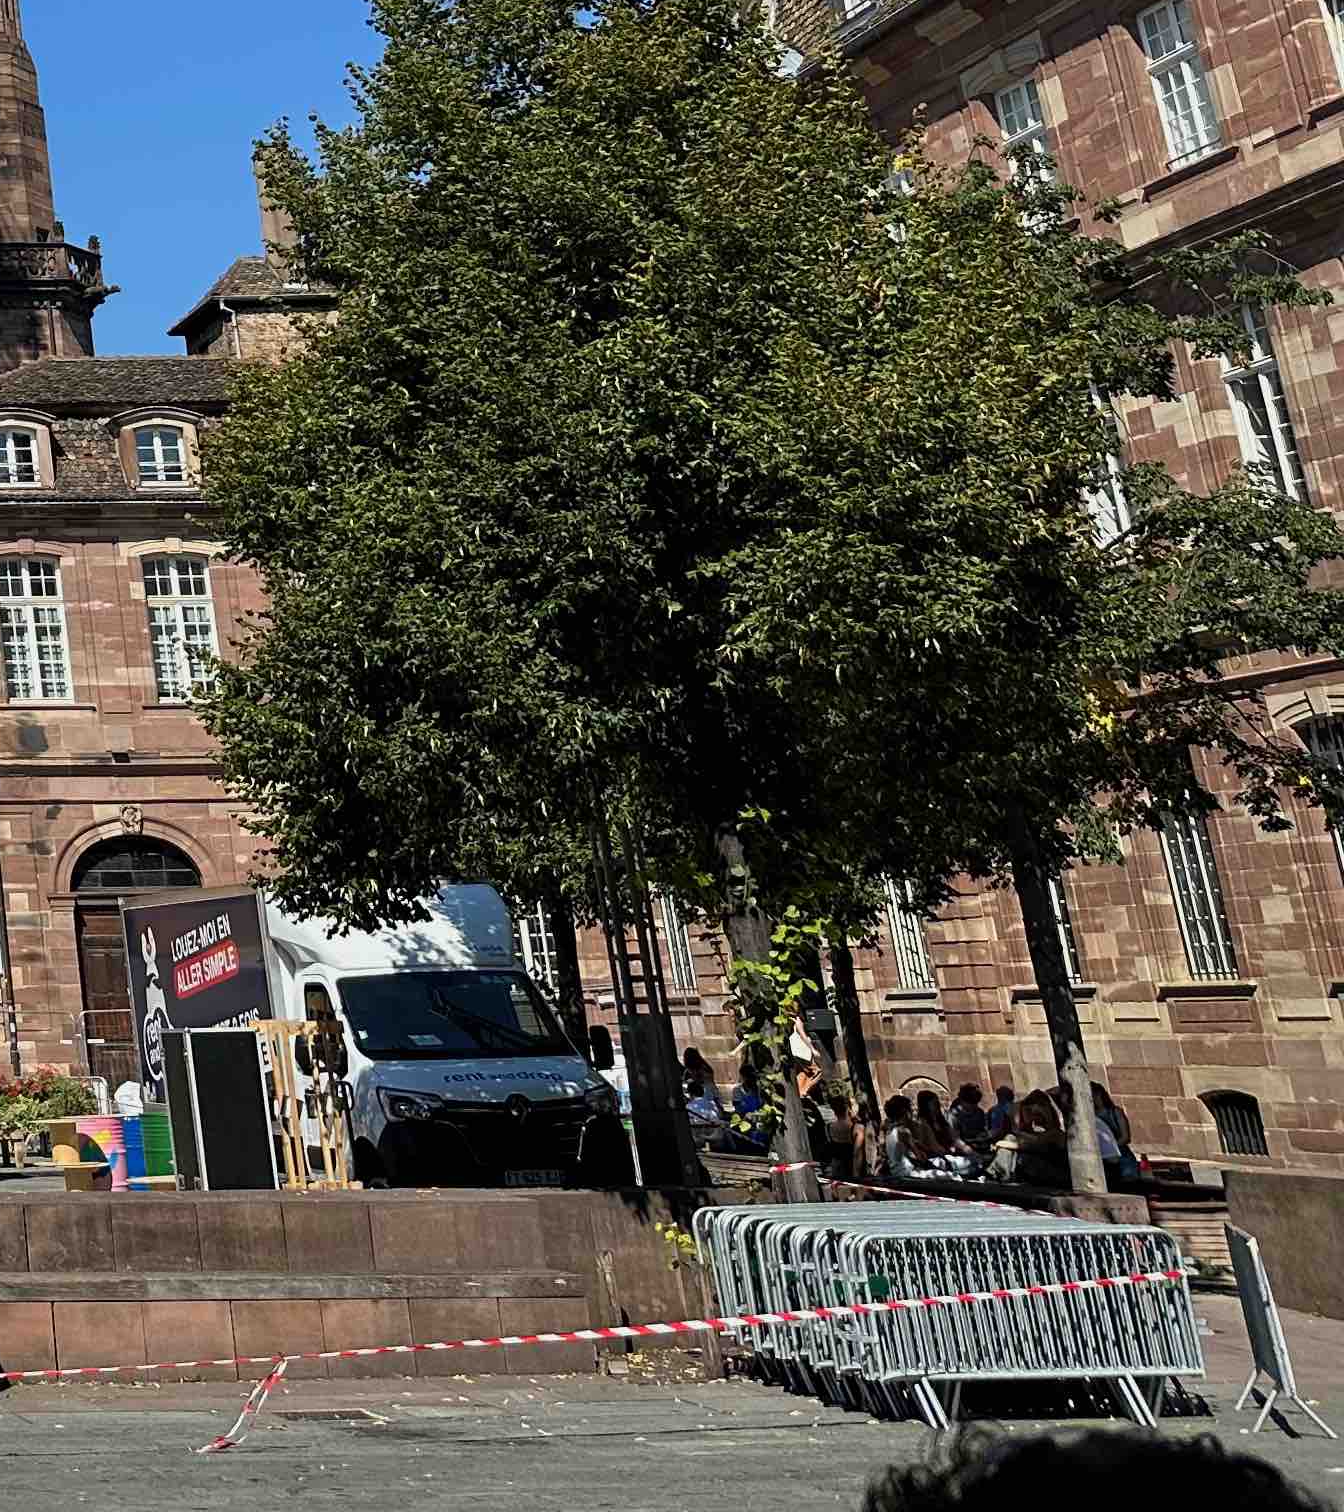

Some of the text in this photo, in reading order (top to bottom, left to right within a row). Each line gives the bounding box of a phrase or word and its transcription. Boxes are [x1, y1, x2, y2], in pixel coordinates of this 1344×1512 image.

[170, 912, 232, 963] LOUEZ-MOI EN
[176, 945, 237, 993] ALLER SIMPLE
